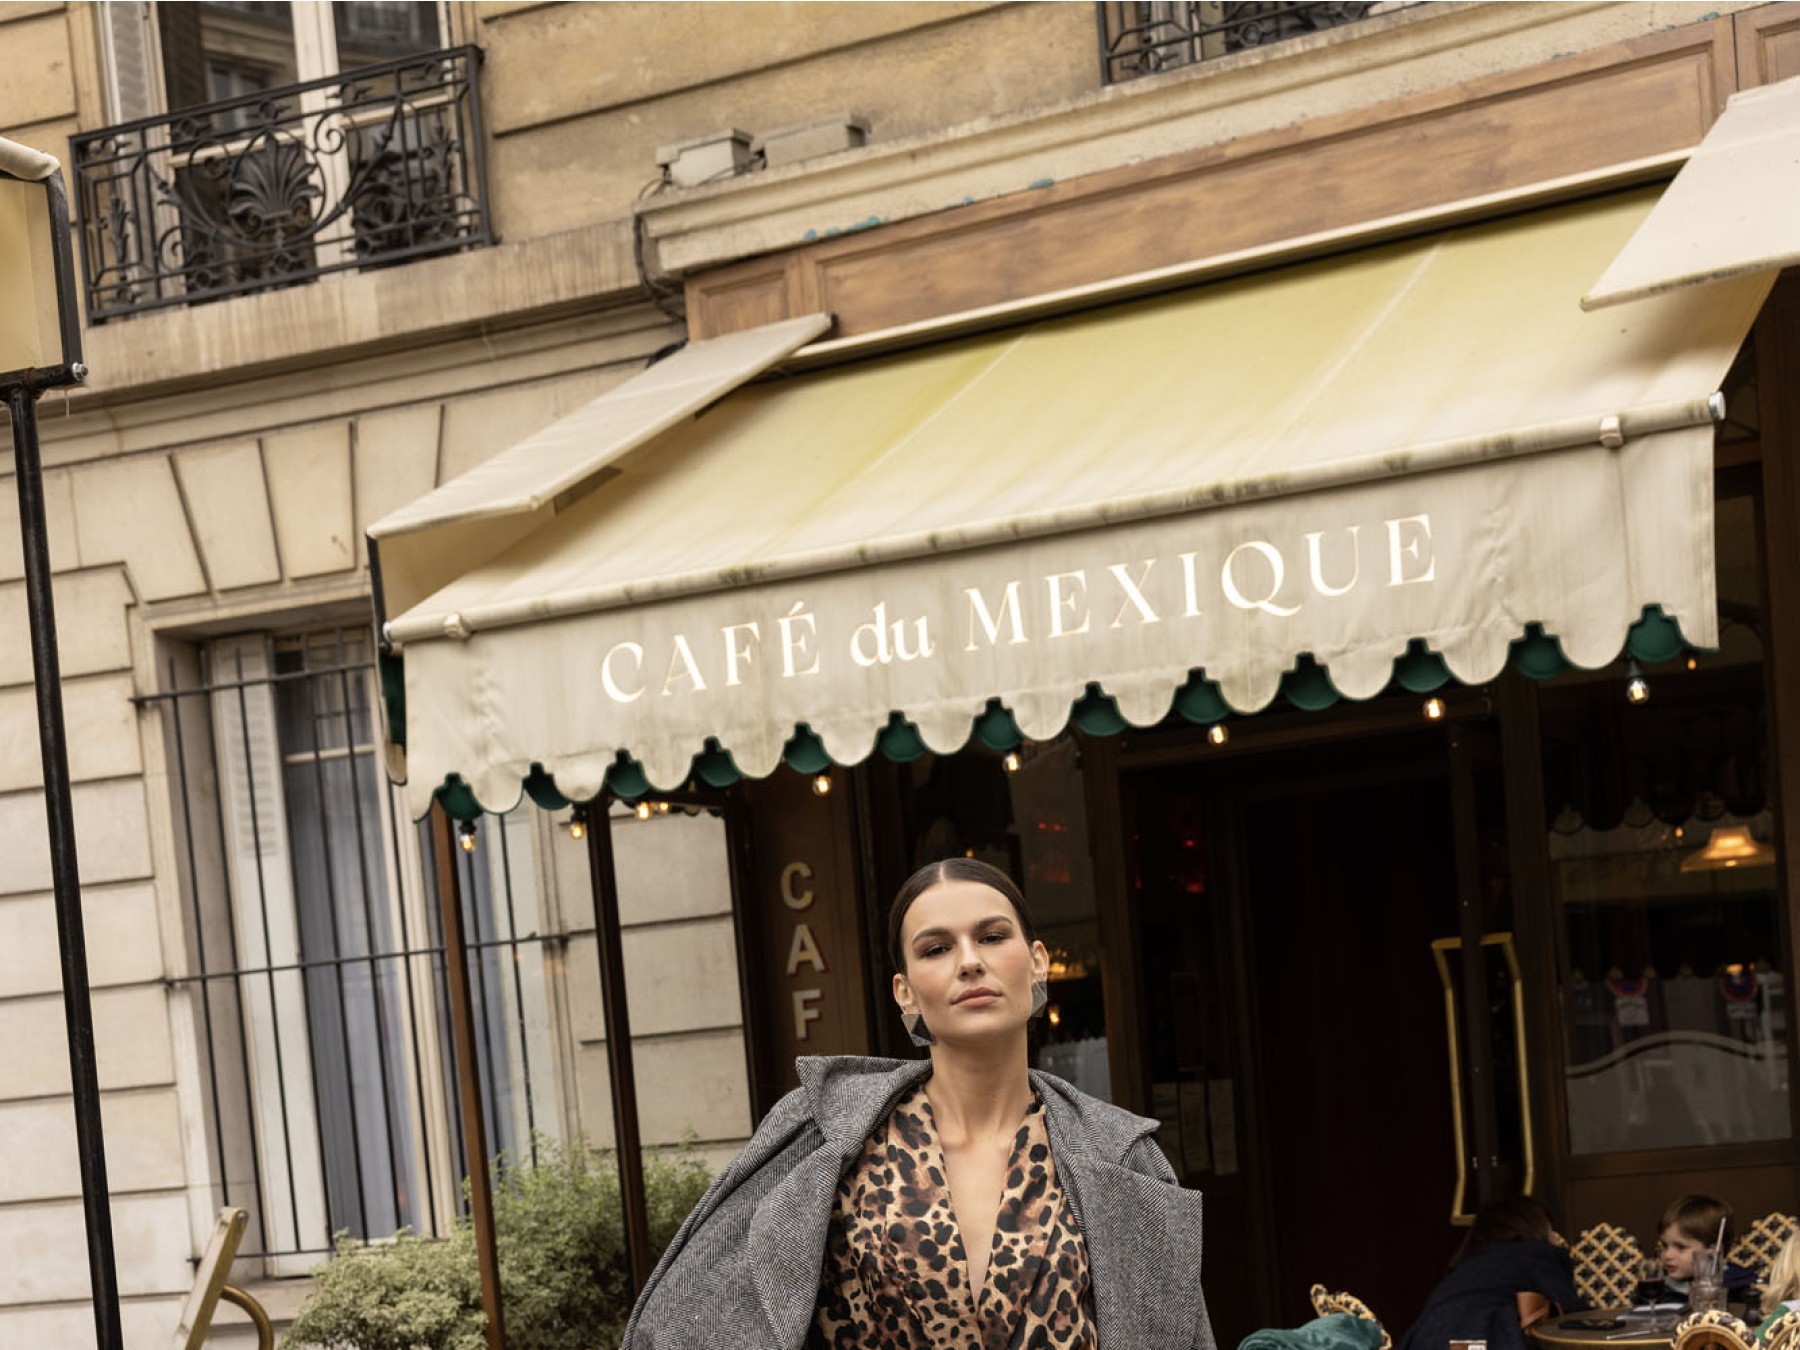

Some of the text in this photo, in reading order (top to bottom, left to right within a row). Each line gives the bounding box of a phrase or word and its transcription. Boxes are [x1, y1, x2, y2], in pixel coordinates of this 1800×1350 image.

[601, 514, 1437, 704] CAFÉ du MEXIQUE
